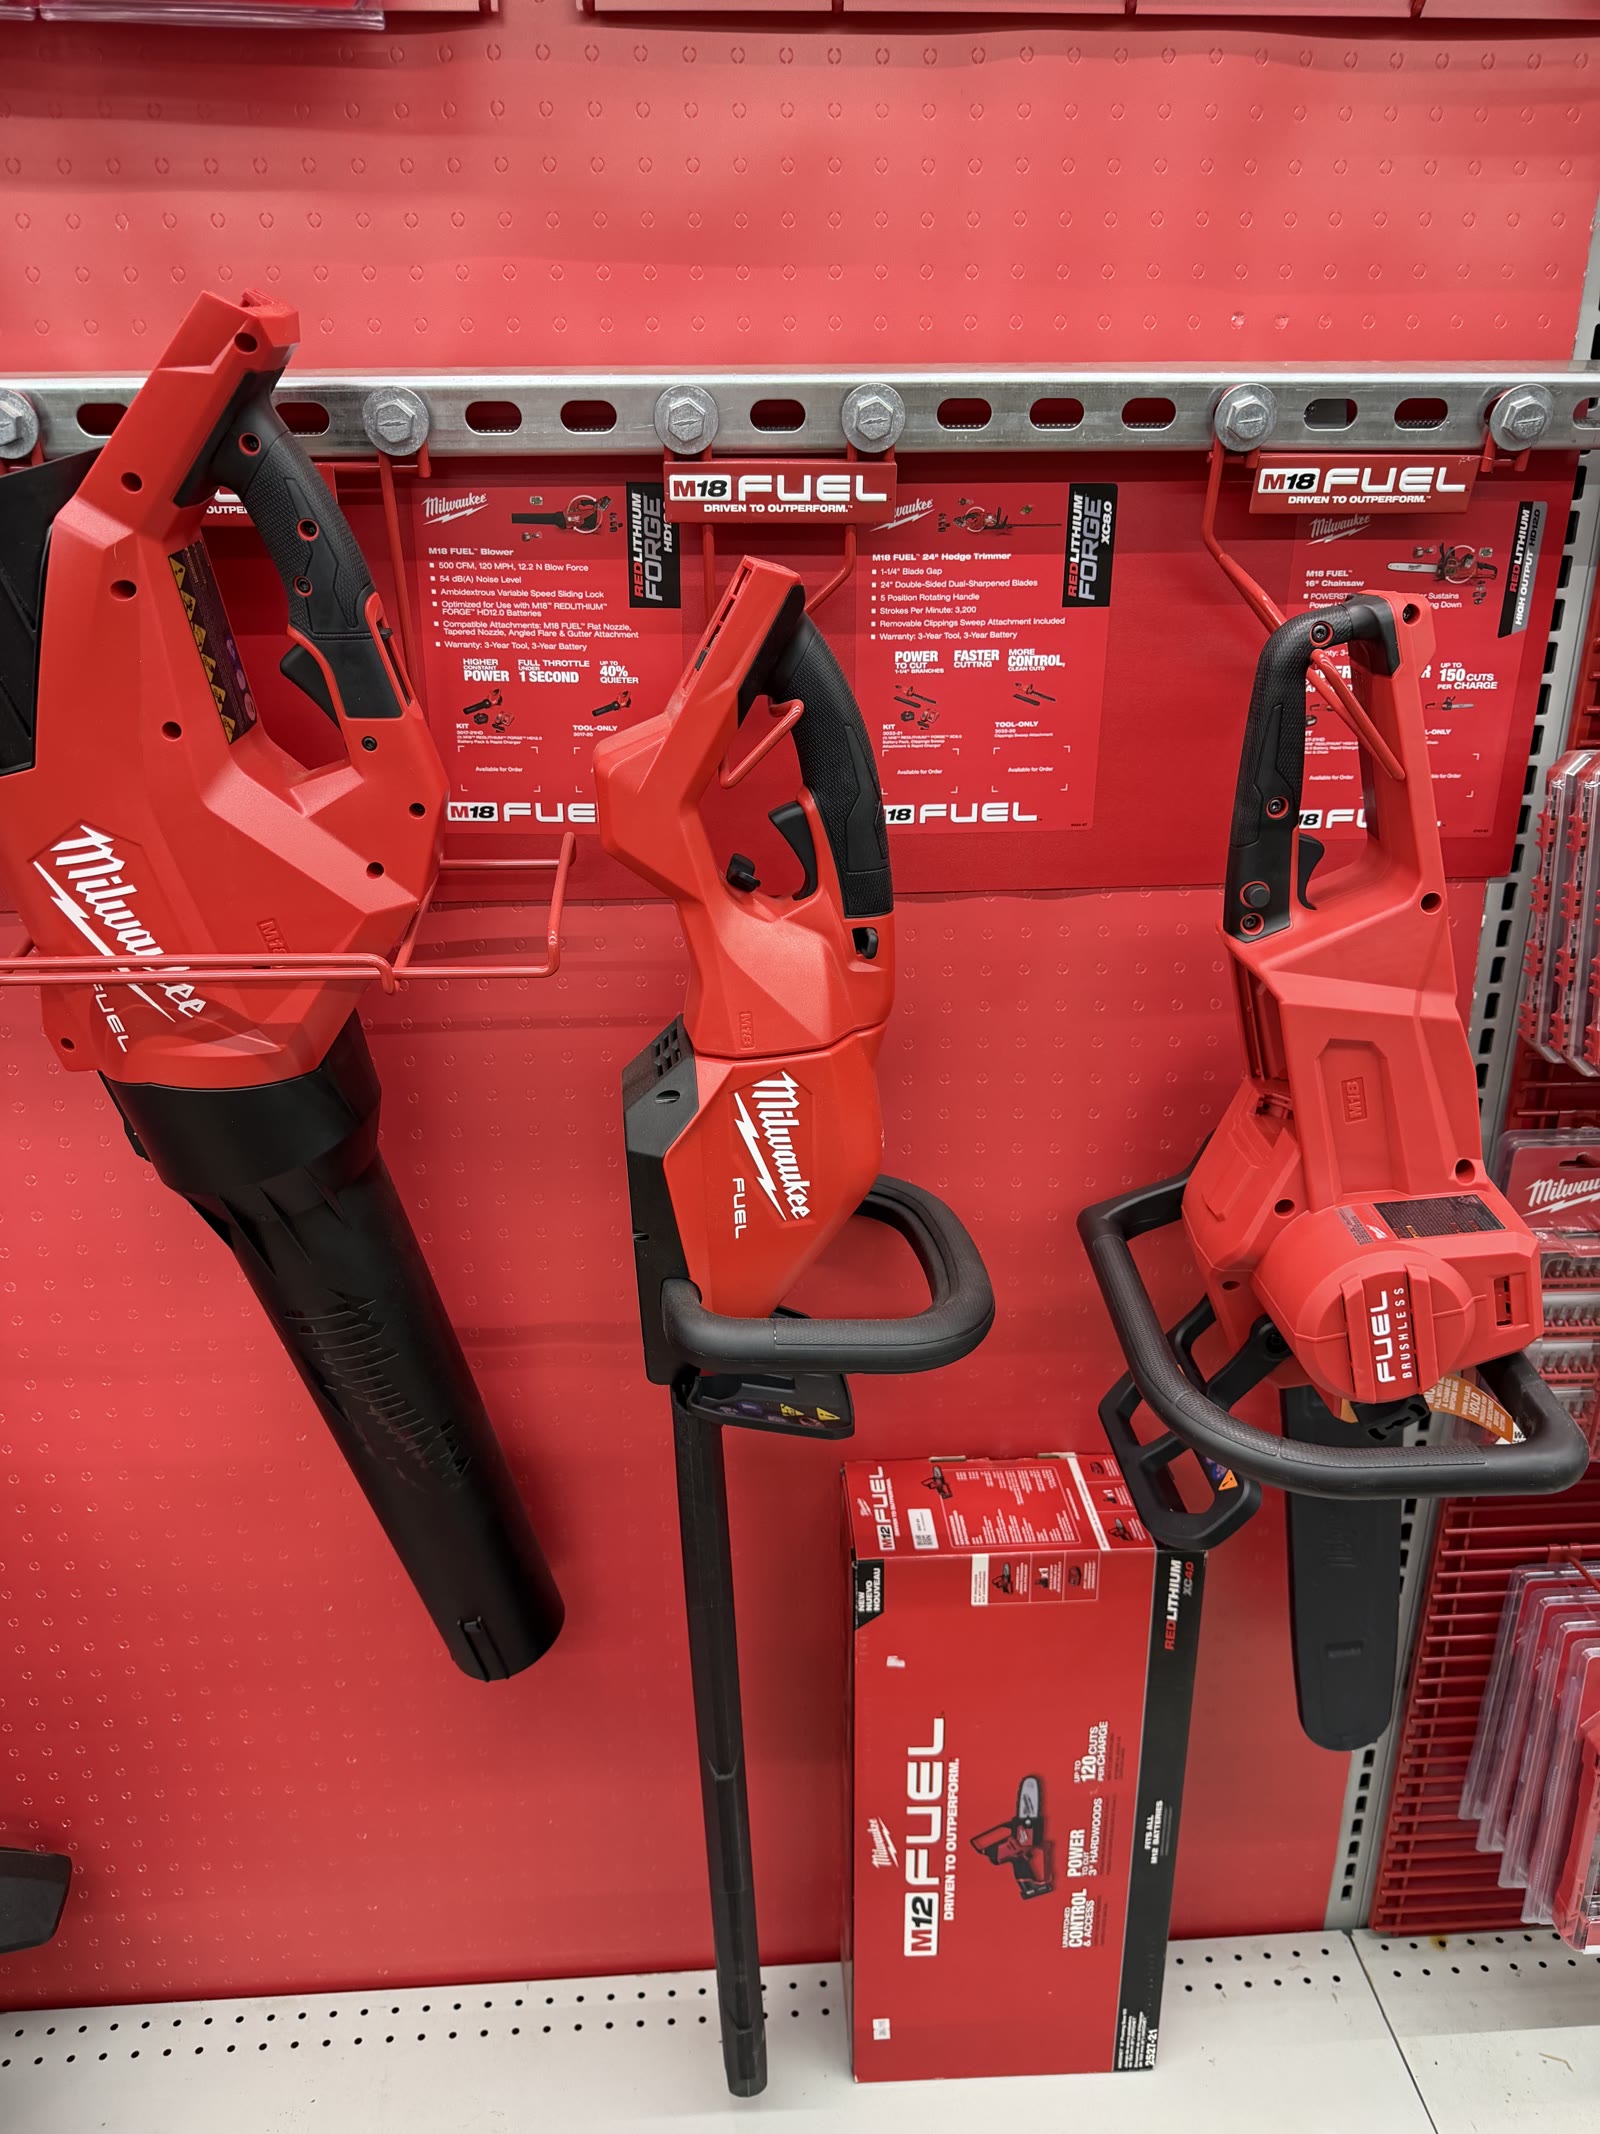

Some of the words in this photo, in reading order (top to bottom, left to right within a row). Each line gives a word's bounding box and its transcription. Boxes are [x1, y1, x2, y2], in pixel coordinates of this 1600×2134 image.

[673, 480, 727, 497] M18
[738, 475, 887, 501] FUEL
[1262, 473, 1316, 490] M18
[1323, 467, 1466, 493] FUEL
[421, 493, 487, 518] Milwaukee
[704, 504, 746, 512] DRIVEN
[749, 504, 765, 512] TO
[1288, 496, 1329, 504] DRIVEN
[1308, 514, 1371, 538] Milwaukee
[481, 548, 514, 556] Blower
[644, 495, 662, 601] FORGE
[1068, 494, 1083, 598] REDLITHIUM
[1079, 499, 1101, 600] FORGE
[1510, 509, 1530, 592] REDLITHIUM
[941, 553, 972, 562] Hedge
[926, 567, 942, 576] Gap
[1520, 551, 1533, 595] OUTPUT
[531, 590, 556, 599] Speed
[895, 580, 946, 588] Double-Sided
[948, 580, 1010, 589] Dual-Sharpened
[1012, 579, 1038, 587] Blades
[496, 601, 511, 609] Use
[512, 601, 530, 609] with
[919, 593, 950, 602] Rotating
[507, 609, 542, 617] Batteries
[880, 619, 921, 627] Removable
[924, 619, 958, 628] Clippings
[960, 619, 986, 627] Sweep
[1033, 617, 1065, 625] Included
[1515, 598, 1526, 625] HIGH
[443, 620, 484, 629] Compatible
[509, 630, 536, 638] Angled
[594, 631, 639, 639] Attachment
[990, 631, 1017, 640] Battery
[532, 642, 557, 650] 3-Year
[559, 643, 587, 651] Battery
[895, 650, 938, 662] POWER
[954, 650, 1000, 661] FASTER
[600, 665, 628, 677] 40%
[1008, 655, 1065, 668] CONTROL,
[464, 670, 509, 682] POWER
[529, 671, 579, 683] SECOND
[1439, 668, 1466, 681] 150
[1466, 673, 1494, 681] CUTS
[1454, 681, 1498, 689] CHARGE
[450, 806, 495, 818] M18
[504, 803, 596, 822] FUE
[887, 809, 911, 821] 18
[920, 802, 1037, 824] FUEL
[50, 824, 206, 1018] Milwauee
[1347, 1081, 1362, 1118] M18
[751, 1071, 810, 1219] Milwaukee
[1525, 1178, 1600, 1207] Milwau
[733, 1178, 747, 1239] FUEL
[1370, 1291, 1396, 1382] FUEL
[1394, 1288, 1412, 1378] BRUSHLESS
[1469, 1392, 1480, 1417] HOLD
[869, 1466, 891, 1523] FUEL
[881, 1526, 891, 1549] M12
[1164, 1560, 1182, 1650] REDLITHIUM
[1081, 1756, 1096, 1782] 120
[1089, 1726, 1099, 1754] CUTS
[1098, 1721, 1108, 1765] CHARGE
[1074, 1760, 1081, 1771] TO
[1097, 1766, 1105, 1781] PER
[1074, 1772, 1080, 1782] UP
[905, 1717, 945, 1885] FUEL
[1089, 1798, 1102, 1863] HARDWOODS
[1146, 1814, 1154, 1830] ALL
[1153, 1800, 1163, 1845] BATTERIES
[1144, 1832, 1152, 1849] FITS
[946, 1854, 956, 1870] TO
[1067, 1829, 1085, 1877] POWER
[1151, 1847, 1159, 1864] M12
[1082, 1866, 1089, 1875] TO
[943, 1873, 955, 1921] DRIVEN
[910, 1896, 934, 1952] M12
[1062, 1907, 1070, 1948] UNMATCHED
[1069, 1888, 1087, 1948] CONTROL
[1084, 1900, 1094, 1937] ACCESS
[1145, 2029, 1158, 2066] 2527-21
